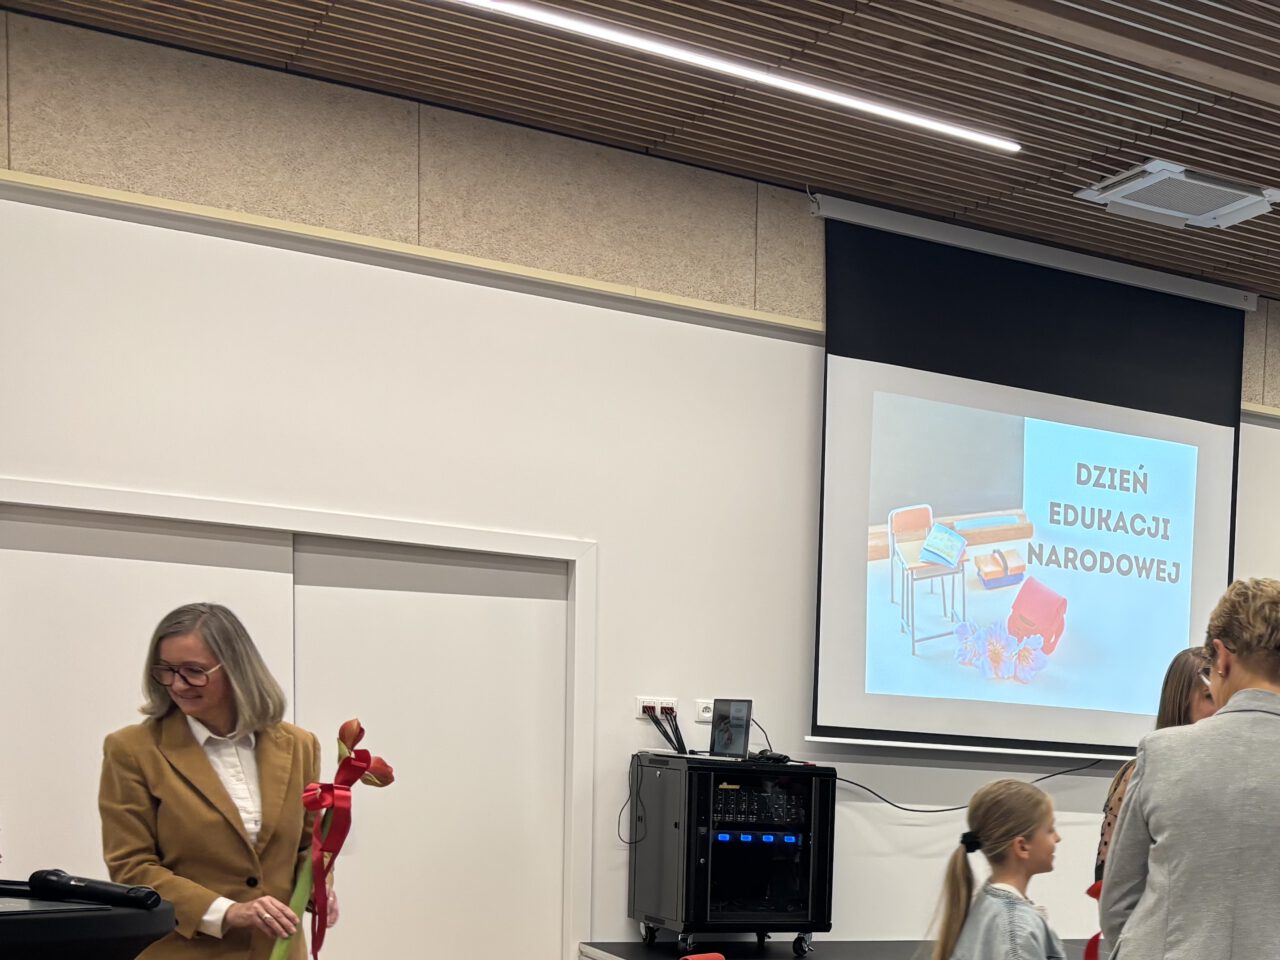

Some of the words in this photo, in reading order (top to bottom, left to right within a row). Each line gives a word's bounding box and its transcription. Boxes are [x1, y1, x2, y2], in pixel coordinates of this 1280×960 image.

[1076, 462, 1148, 494] DZIEŃ
[1049, 501, 1171, 541] EDUKACJI
[1027, 542, 1181, 584] NARODOWEJ
